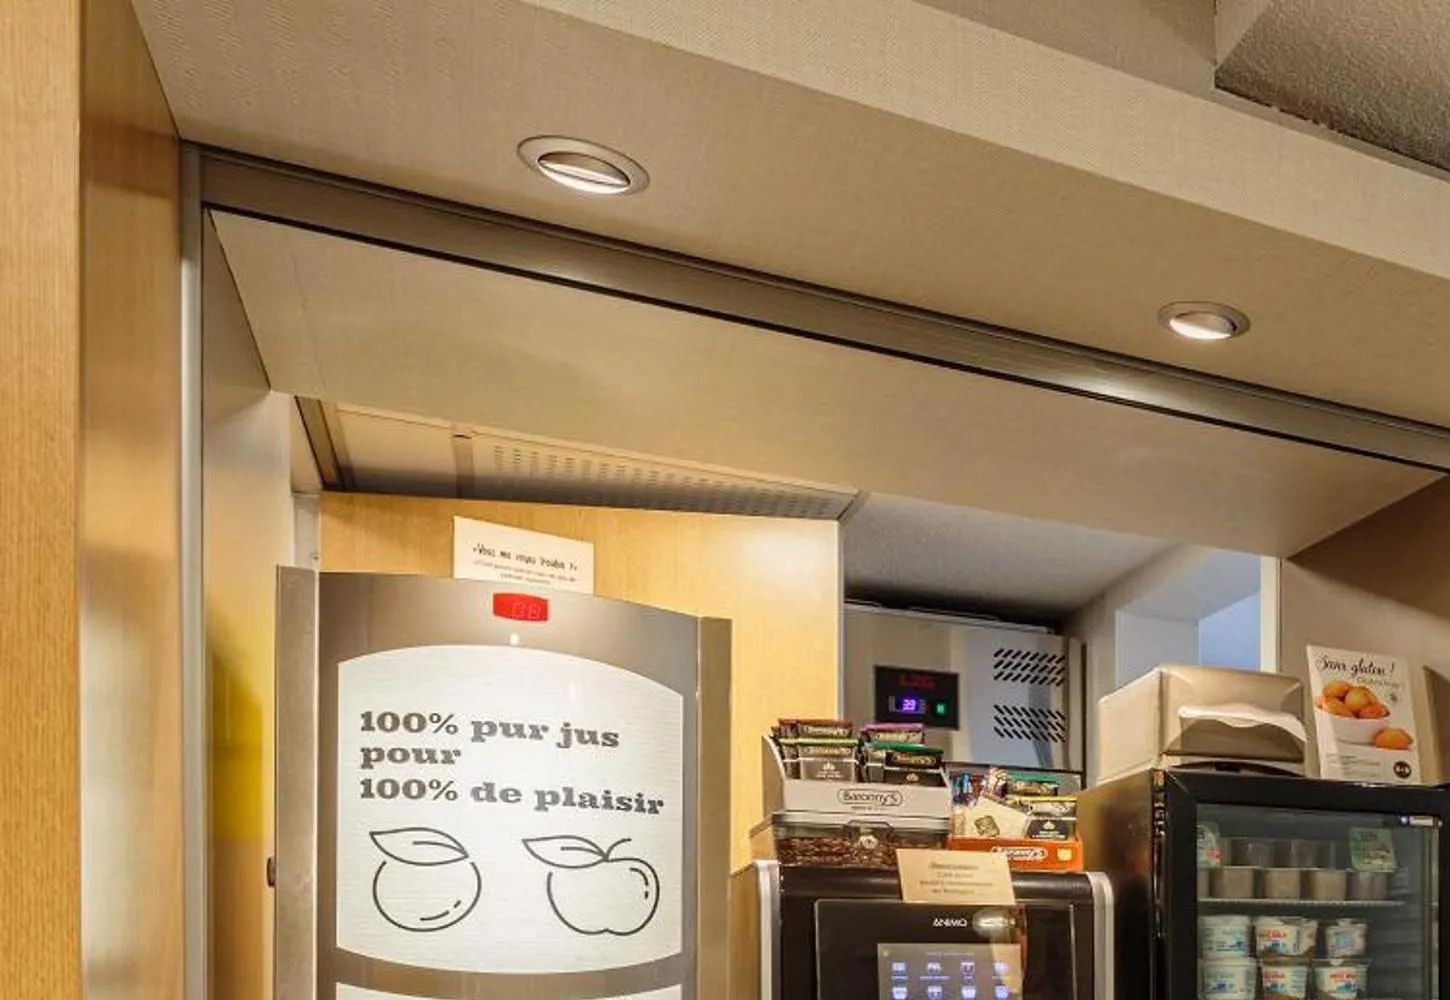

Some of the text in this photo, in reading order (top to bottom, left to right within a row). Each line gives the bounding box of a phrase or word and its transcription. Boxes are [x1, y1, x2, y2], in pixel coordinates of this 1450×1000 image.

[359, 710, 620, 749] 100% pur jus
[359, 746, 462, 770] pour
[359, 777, 665, 815] 100% de plaisir
